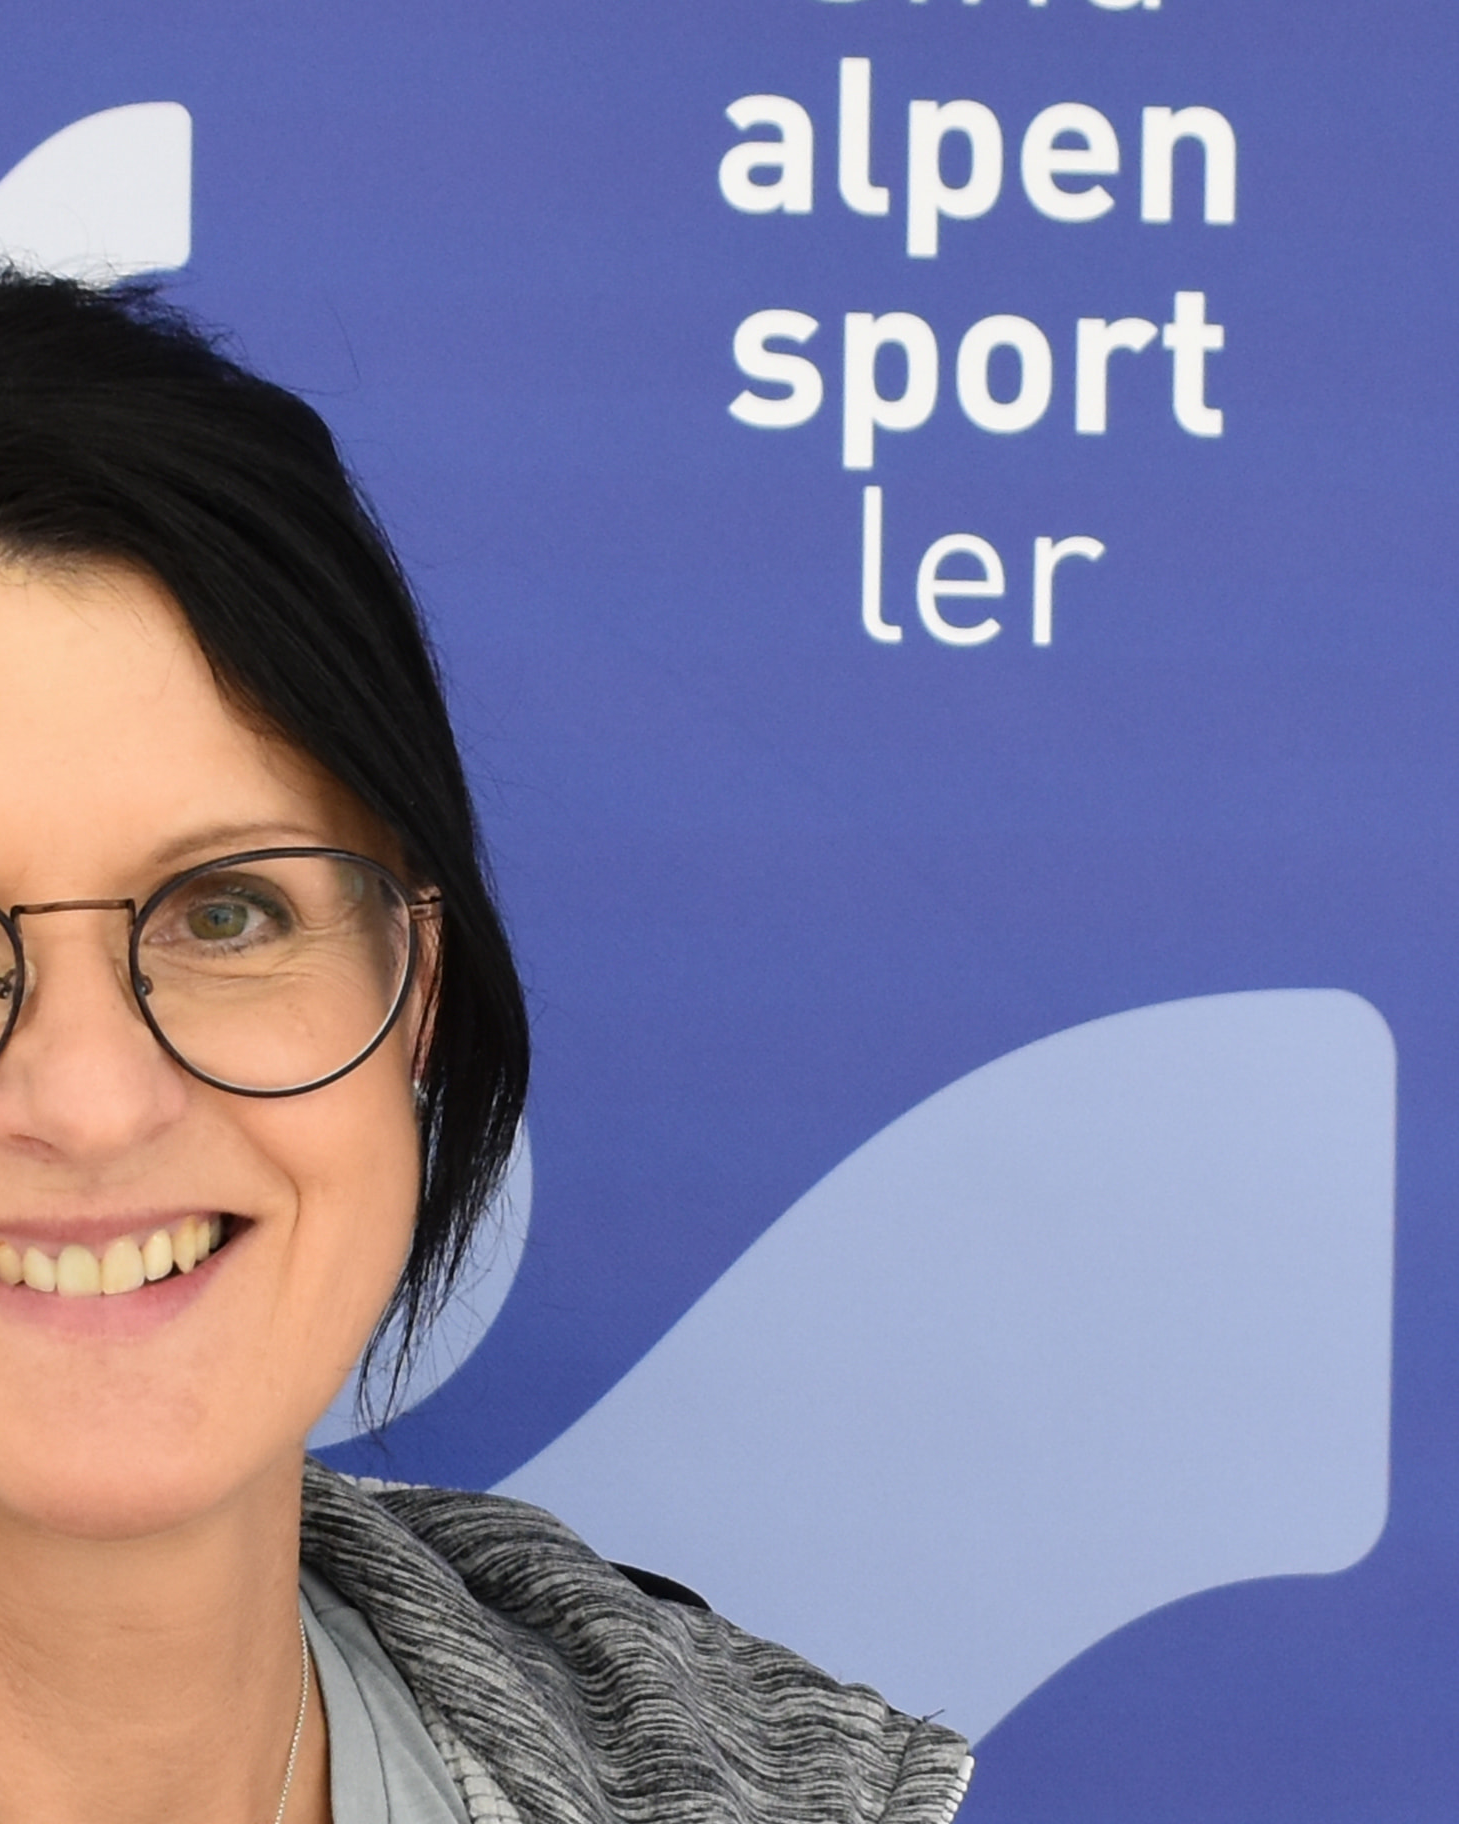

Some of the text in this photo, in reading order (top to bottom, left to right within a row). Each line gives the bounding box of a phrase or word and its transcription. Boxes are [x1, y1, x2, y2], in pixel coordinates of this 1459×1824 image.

[718, 56, 1237, 258] alpen
[728, 290, 1225, 470] sport
[861, 485, 1106, 646] ler
